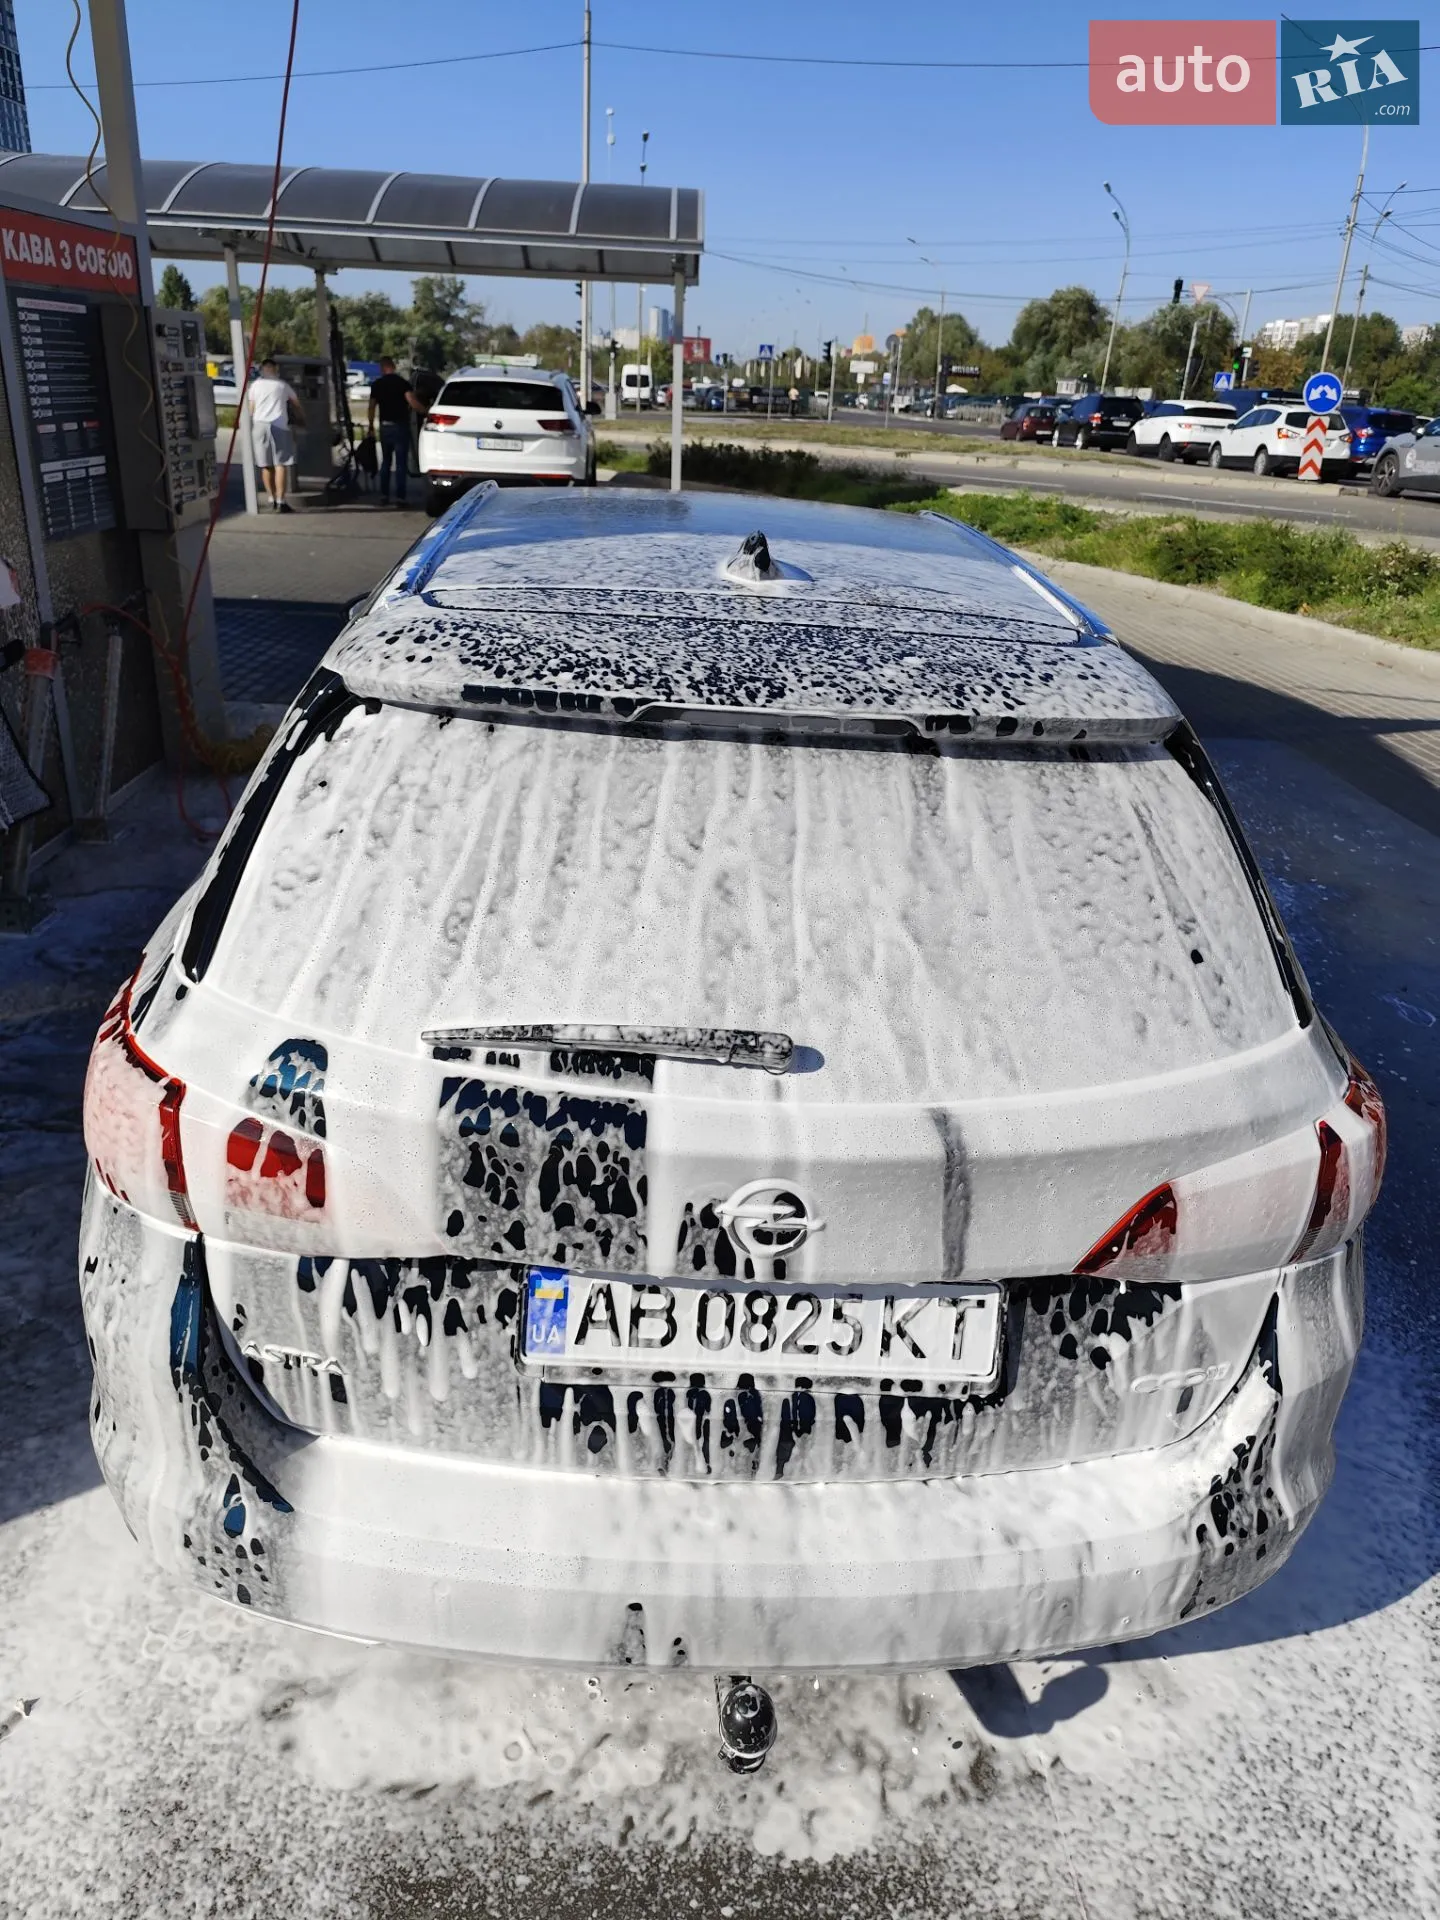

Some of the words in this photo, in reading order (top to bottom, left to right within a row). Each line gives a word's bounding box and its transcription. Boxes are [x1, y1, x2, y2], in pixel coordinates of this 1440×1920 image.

[2, 228, 57, 268] КАВА
[532, 1324, 563, 1345] UA
[695, 1288, 865, 1357] 0825
